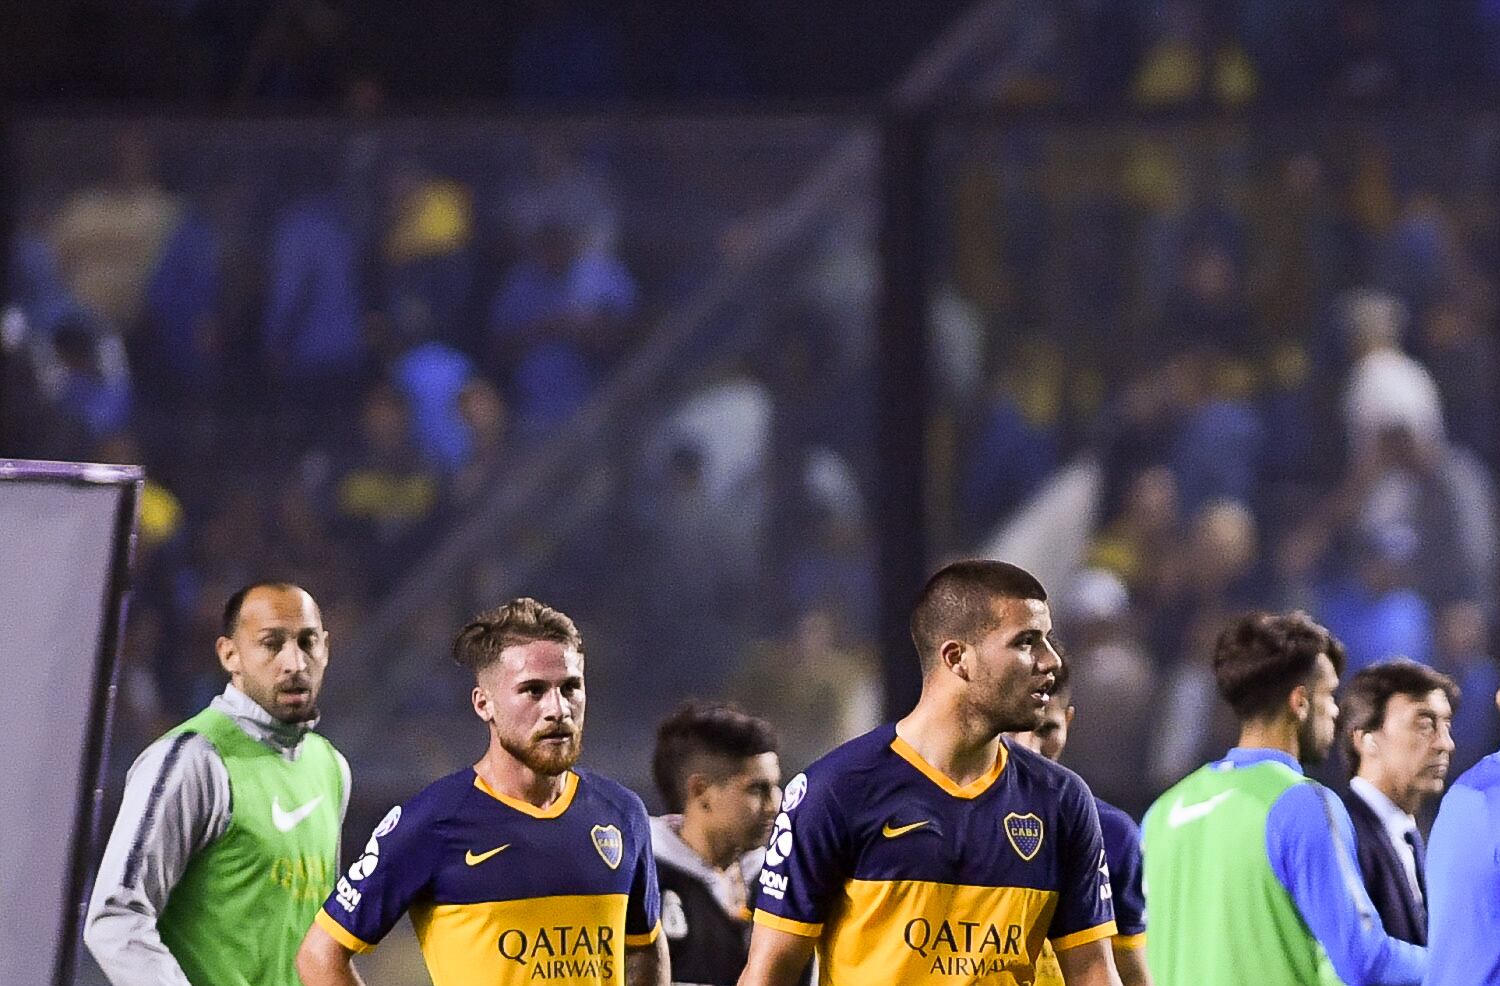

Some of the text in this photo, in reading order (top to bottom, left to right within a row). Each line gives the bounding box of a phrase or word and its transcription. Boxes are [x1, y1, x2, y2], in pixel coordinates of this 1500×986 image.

[1011, 827, 1039, 837] CABJ
[498, 926, 614, 965] QATAR
[904, 917, 1022, 958] QATAR
